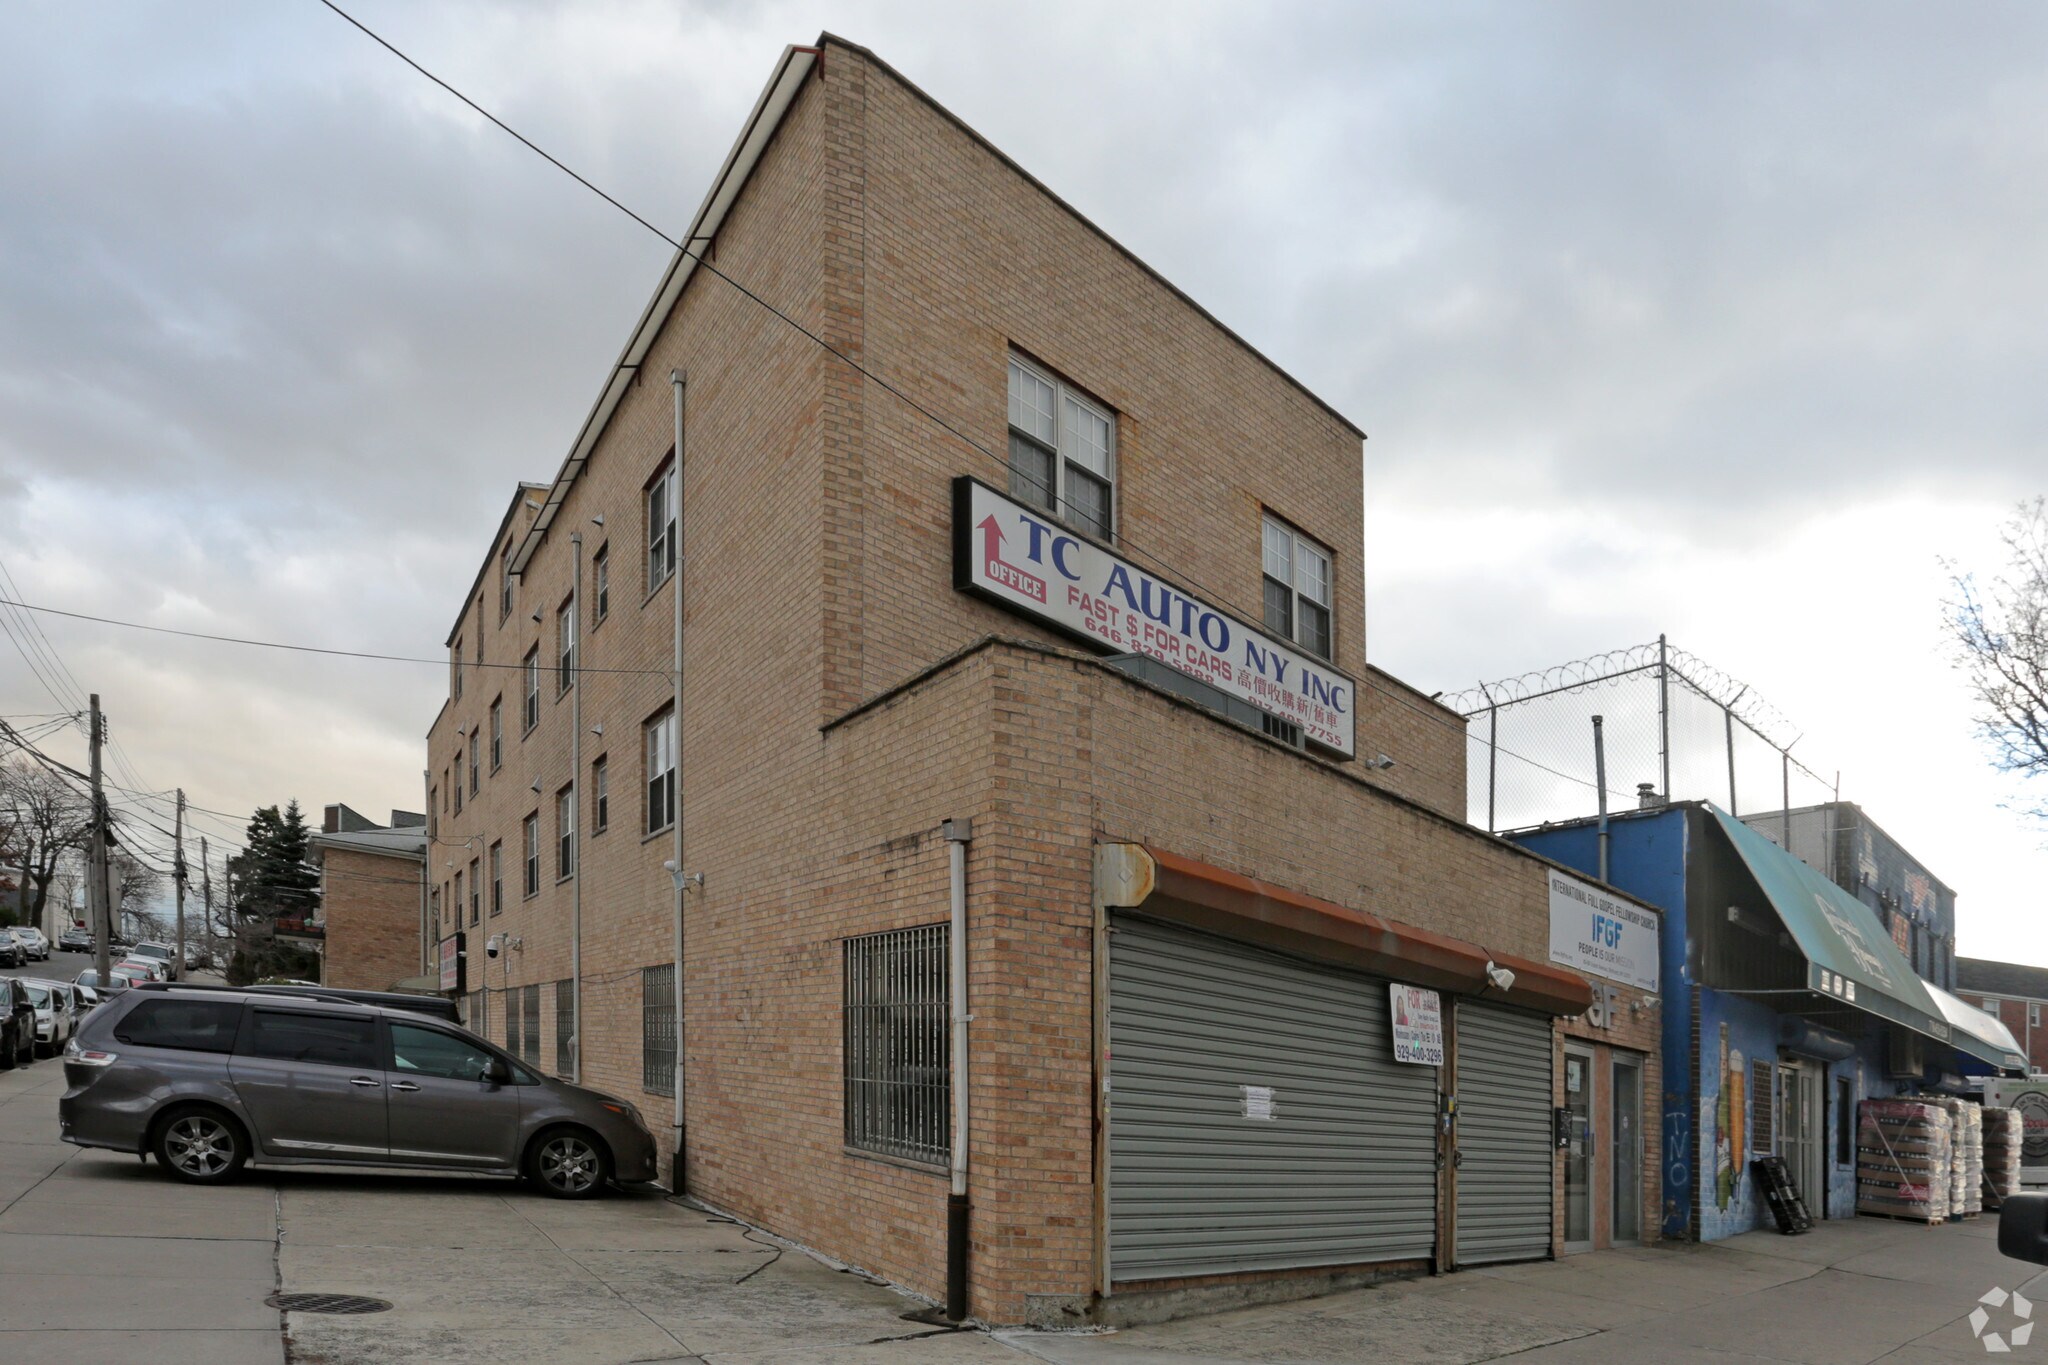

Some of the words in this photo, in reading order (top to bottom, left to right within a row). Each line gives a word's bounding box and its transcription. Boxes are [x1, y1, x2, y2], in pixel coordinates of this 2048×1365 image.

[989, 560, 1043, 599] OFFICE
[1020, 514, 1081, 581] TC
[1101, 563, 1230, 653] AUTO
[1245, 638, 1290, 684] NY
[1302, 667, 1346, 714] INC
[1068, 585, 1119, 626] FAST
[1126, 613, 1138, 638] $
[1144, 622, 1180, 657] FOR
[1186, 643, 1232, 682] CARS
[1552, 879, 1587, 904] INTERNATIONAL
[1588, 893, 1599, 909] FULL
[1599, 898, 1615, 916] GOSPEL
[1616, 905, 1640, 925] FELLOWSHIP
[1640, 915, 1656, 930] CHURCH
[1578, 941, 1598, 958] PEOPLE
[1599, 949, 1604, 960] IS
[1592, 913, 1623, 950] IFGF
[1407, 989, 1421, 1010] FOR
